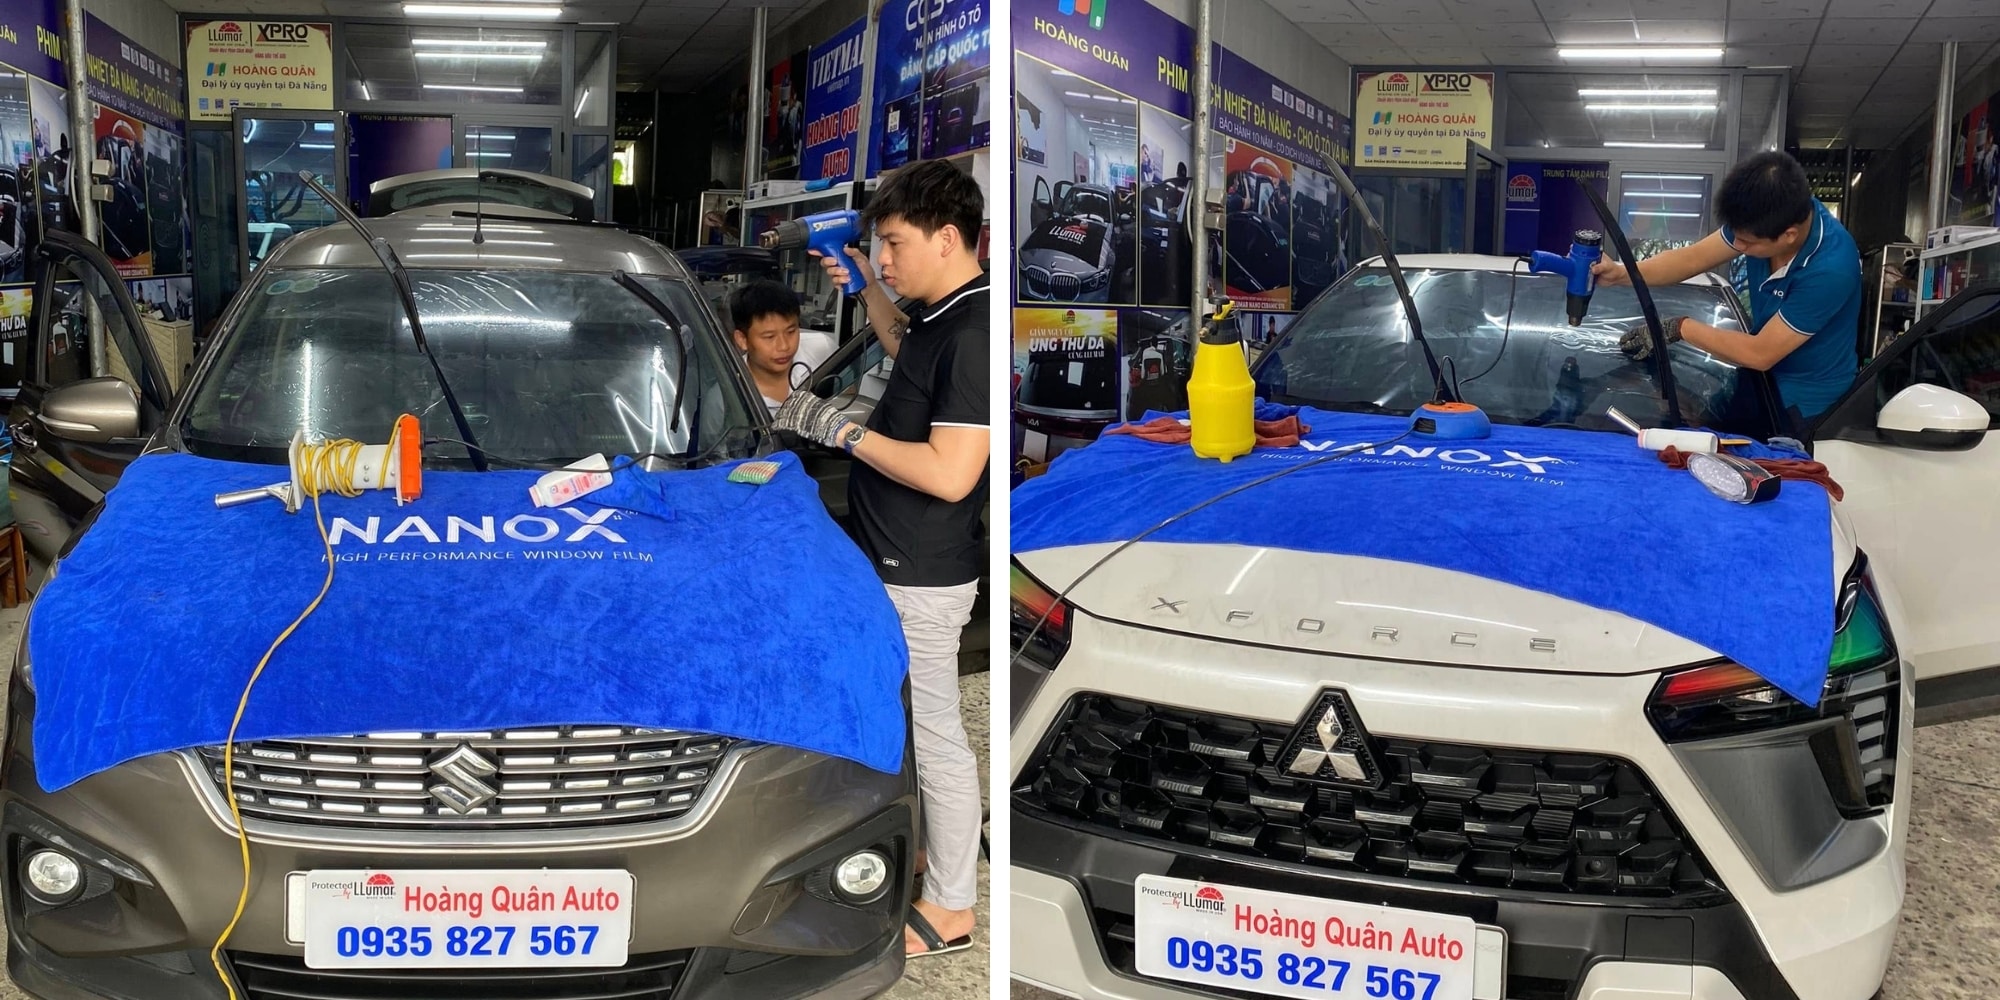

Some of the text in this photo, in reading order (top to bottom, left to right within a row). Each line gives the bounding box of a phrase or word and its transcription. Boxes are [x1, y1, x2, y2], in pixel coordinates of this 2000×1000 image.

[935, 18, 957, 41] HÌNH
[959, 11, 966, 30] Ô
[968, 3, 981, 25] TÔ
[208, 29, 242, 41] LLumar
[256, 24, 308, 42] XPRO
[37, 25, 61, 61] PHIM
[947, 29, 980, 64] QUỐC
[1034, 16, 1129, 72] HOÀNG QUÂN
[233, 64, 315, 76] HOÀNG QUÂN
[1157, 55, 1188, 94] PHIM
[202, 80, 217, 89] Đại
[220, 80, 228, 89] lý
[275, 81, 286, 90] tại
[1377, 80, 1409, 92] LLumar
[1422, 74, 1472, 92] XPRO
[1224, 88, 1252, 126] NHIỆT
[1254, 101, 1266, 130] ĐÀ
[1297, 125, 1314, 150] CHO
[1398, 113, 1476, 124] HOÀNG QUÂN
[806, 111, 840, 148] HOÀNG
[1368, 128, 1382, 136] Đại
[822, 147, 850, 179] AUTO
[1543, 169, 1565, 177] TRUNG
[1049, 225, 1087, 242] LLumar
[1087, 336, 1105, 350] DA
[1440, 464, 1516, 479] WINDOW
[1523, 475, 1564, 486] FILM
[328, 506, 628, 544] NANOX
[377, 551, 515, 561] PERFORMANCE
[523, 550, 603, 560] WINDOW
[613, 551, 654, 563] FILM
[311, 882, 353, 890] Protected
[354, 882, 395, 896] LLumar
[1141, 886, 1183, 900] Protected
[405, 886, 619, 919] Hoàng Quân Auto
[1183, 892, 1225, 912] LLumar
[337, 925, 599, 957] 0935 827 567
[1235, 904, 1463, 961] Hoàng Quân Auto
[1167, 937, 1442, 1000] 0935 827 567
